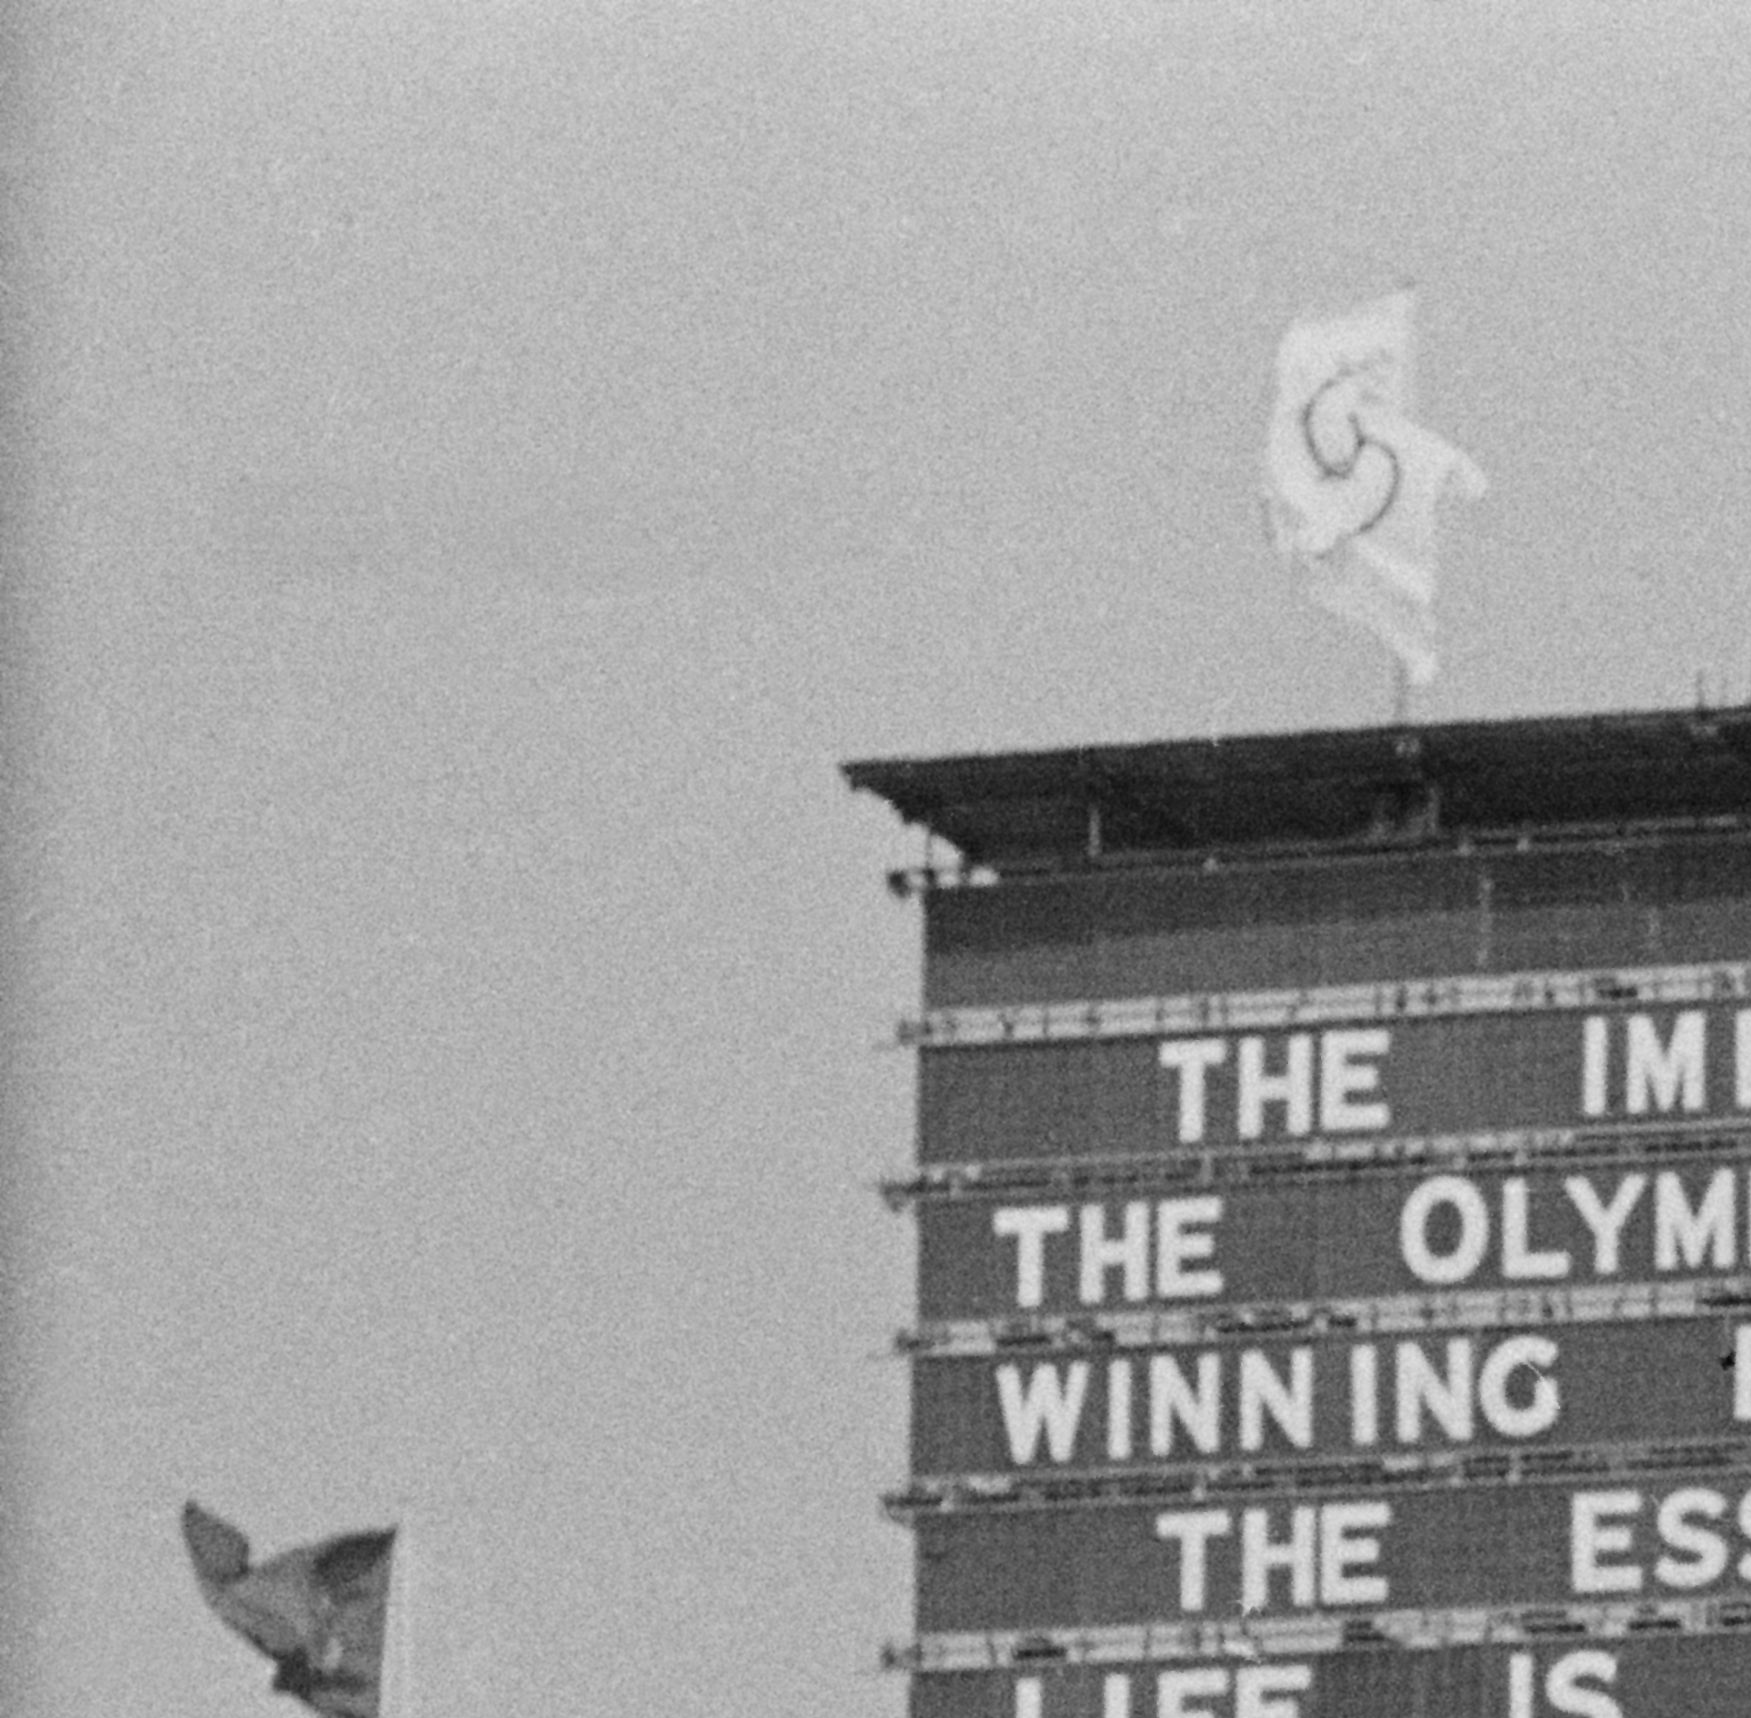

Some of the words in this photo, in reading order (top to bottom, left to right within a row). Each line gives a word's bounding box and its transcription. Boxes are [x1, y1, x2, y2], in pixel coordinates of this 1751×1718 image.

[1159, 1029, 1392, 1144] THE
[993, 1196, 1225, 1305] THE
[996, 1335, 1561, 1465] WINNING
[1156, 1501, 1393, 1612] THE
